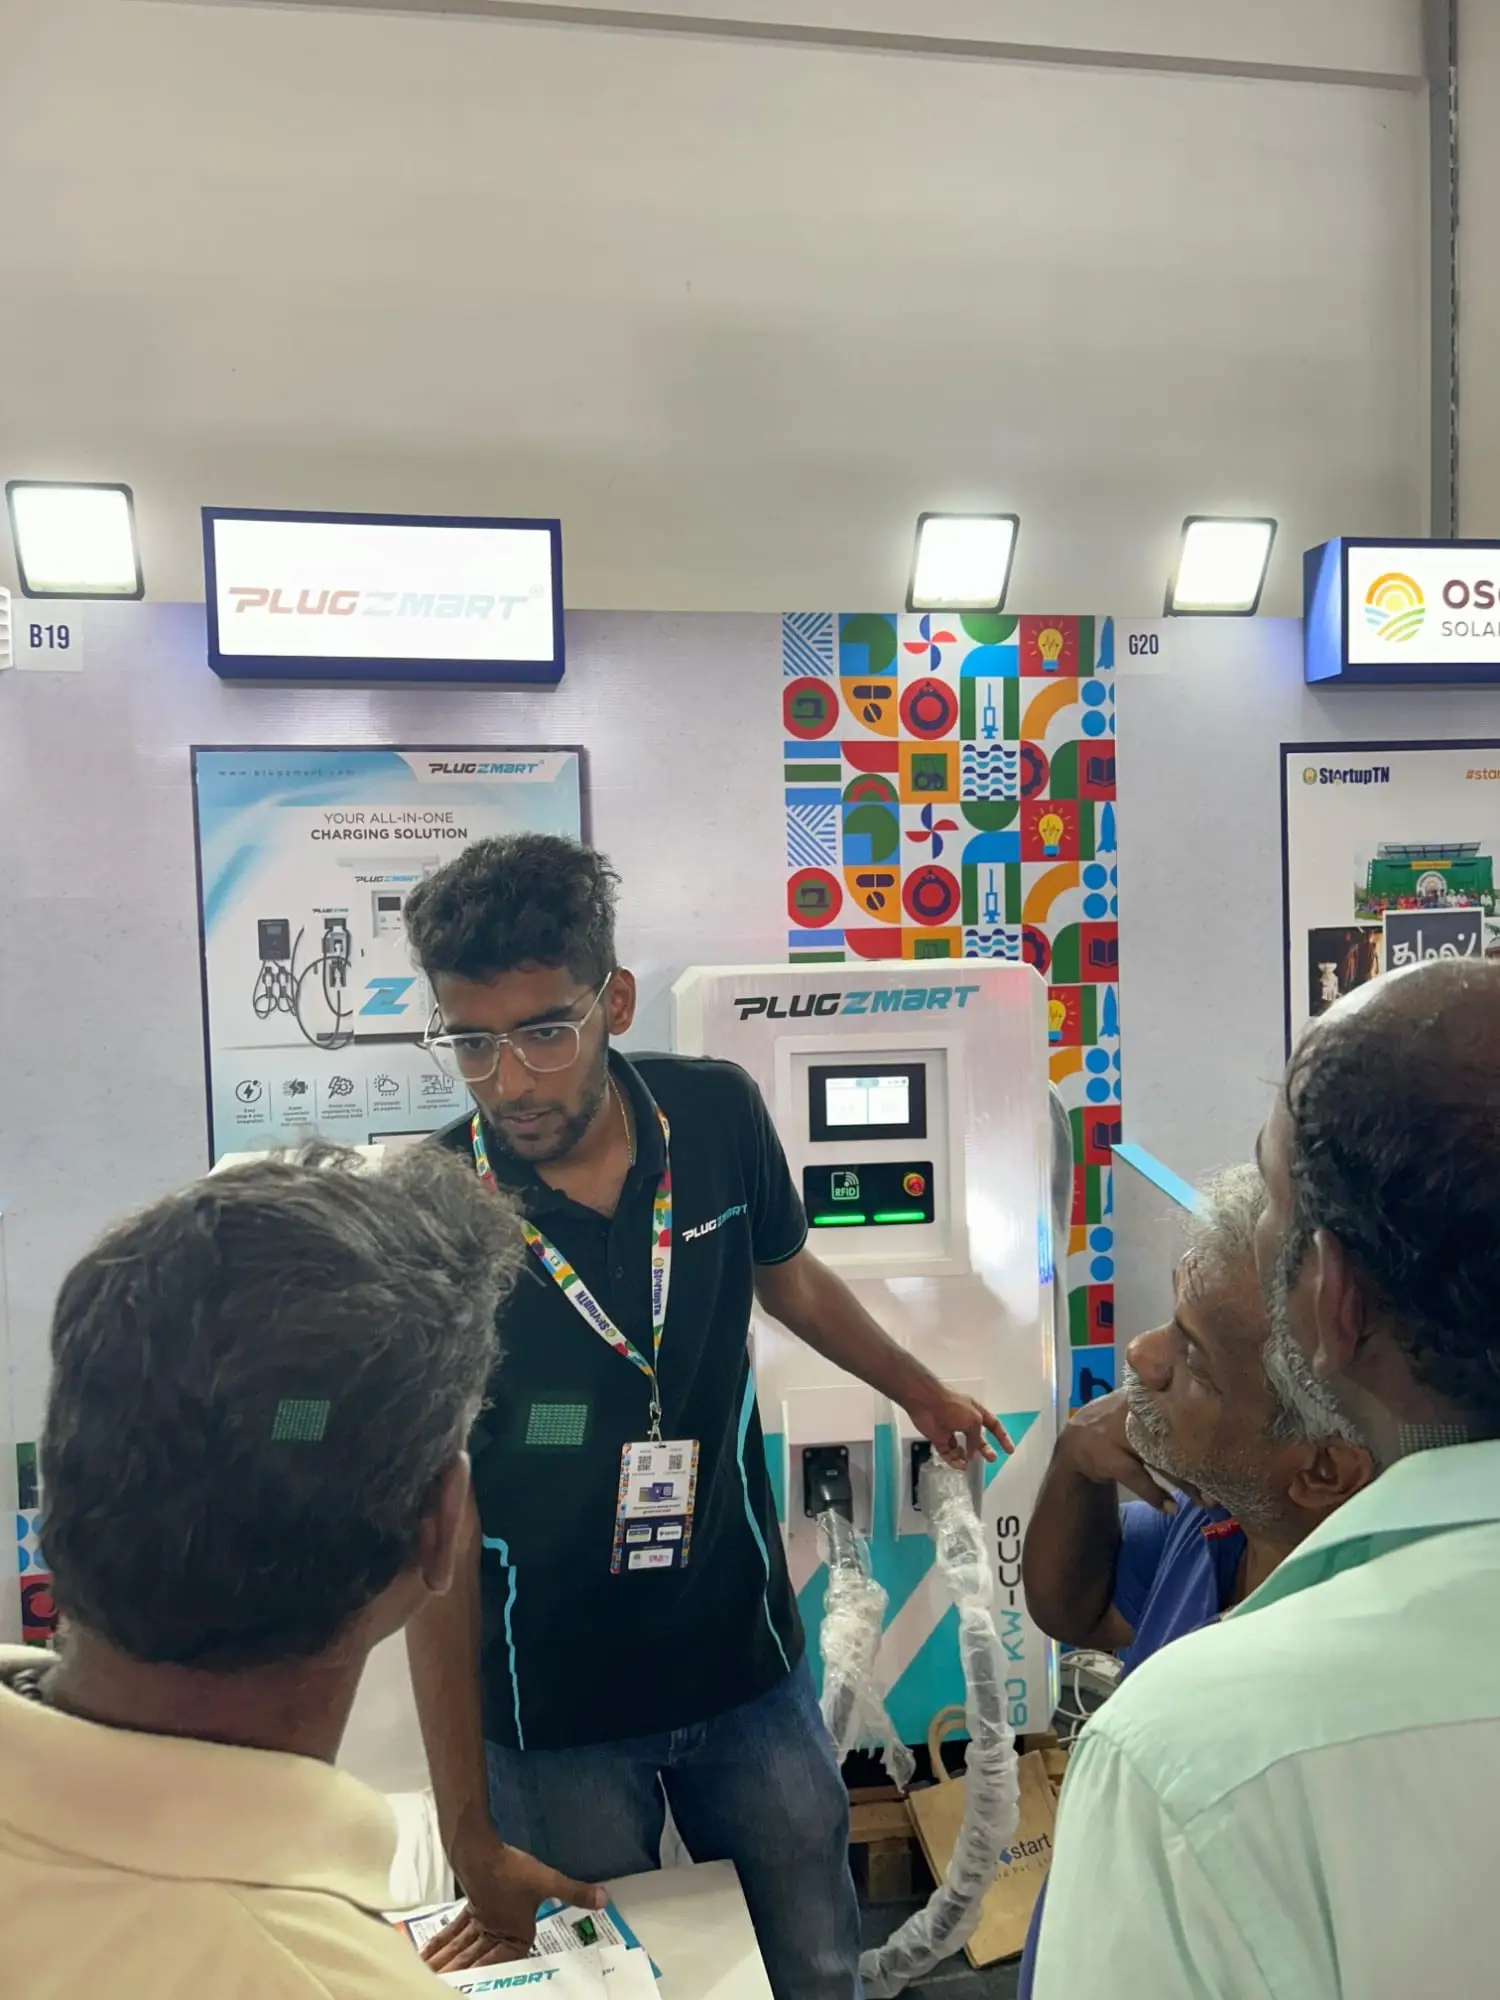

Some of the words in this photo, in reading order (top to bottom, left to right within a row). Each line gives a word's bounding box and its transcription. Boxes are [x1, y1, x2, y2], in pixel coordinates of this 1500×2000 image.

[1442, 579, 1500, 610] OS
[29, 623, 70, 650] B19
[1441, 620, 1500, 638] SOLA
[1128, 633, 1159, 655] G20
[1319, 766, 1390, 785] StartupTN
[324, 812, 364, 825] YOUR
[370, 811, 454, 825] ALL-IN-ONE
[310, 828, 390, 841] CHARGING
[394, 827, 468, 840] SOLUTION
[734, 984, 981, 1021] PLUGZMART
[834, 1187, 856, 1197] RFID
[1004, 1678, 1028, 1727] 60
[1010, 1832, 1053, 1860] start
